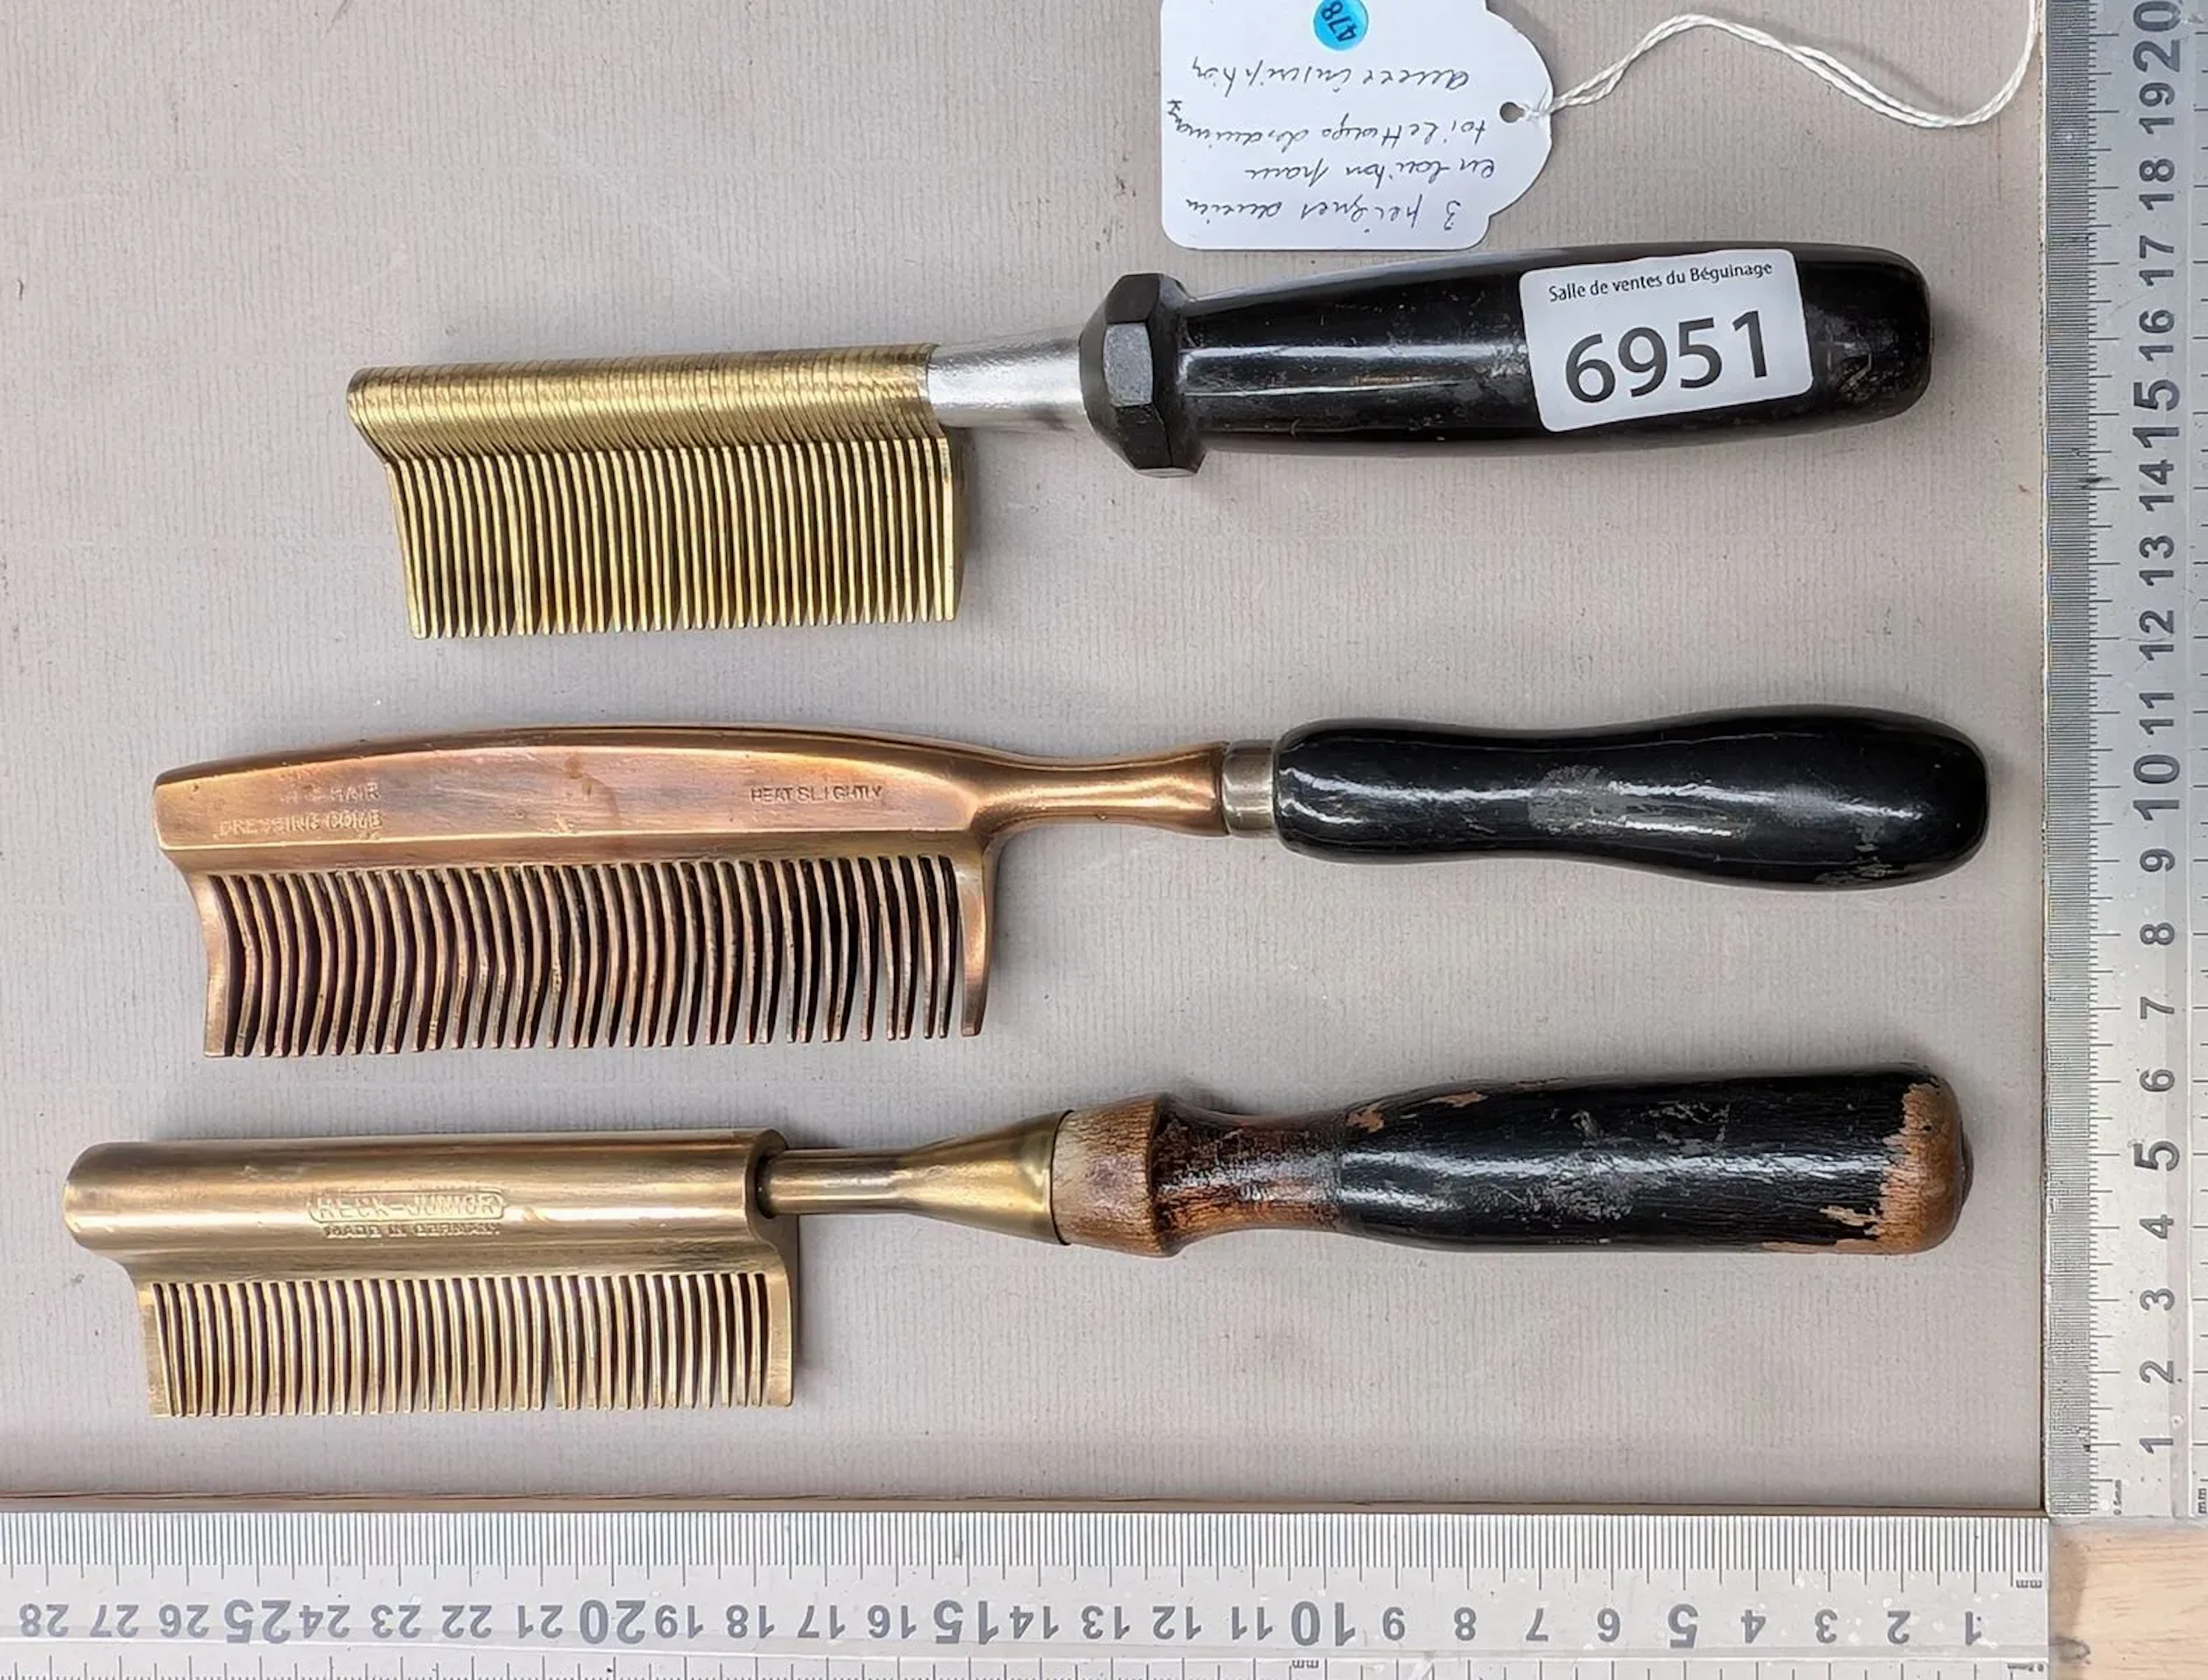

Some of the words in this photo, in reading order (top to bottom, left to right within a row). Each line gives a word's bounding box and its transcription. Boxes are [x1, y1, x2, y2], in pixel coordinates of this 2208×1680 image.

[1321, 0, 1358, 43] 478
[2133, 1, 2181, 72] 20
[2138, 82, 2175, 135] 19
[2138, 158, 2175, 210] 18
[1444, 200, 1462, 231] 3
[2138, 235, 2175, 286] 17
[1549, 284, 1586, 302] Salle
[1590, 279, 1608, 296] de
[1612, 274, 1662, 292] ventes
[1666, 269, 1686, 285] du
[1690, 262, 1773, 283] Béguinage
[2138, 309, 2175, 362] 16
[1565, 309, 1769, 404] 6951
[2133, 379, 2181, 448] 15
[2138, 459, 2175, 512] 14
[2138, 535, 2175, 586] 13
[2138, 610, 2175, 661] 12
[2138, 692, 2175, 735] 11
[2133, 754, 2181, 821] 10
[2138, 849, 2175, 872] 9
[2138, 922, 2175, 946] 8
[2138, 996, 2175, 1019] 7
[2138, 1069, 2175, 1092] 6
[2133, 1141, 2181, 1172] 5
[324, 1225, 382, 1239] MADE
[388, 1223, 407, 1238] IN
[2138, 1214, 2175, 1240] 4
[2138, 1288, 2175, 1313] 3
[2138, 1360, 2175, 1384] 2
[2138, 1435, 2175, 1455] 1
[2015, 1579, 2042, 1589] mm
[19, 1603, 70, 1637] 28
[89, 1604, 140, 1637] 27
[159, 1604, 209, 1638] 26
[225, 1599, 291, 1644] 25
[299, 1604, 351, 1638] 24
[371, 1604, 421, 1638] 23
[442, 1604, 493, 1638] 22
[518, 1605, 563, 1639] 21
[579, 1600, 646, 1641] 20
[655, 1605, 703, 1639] 19
[726, 1605, 775, 1639] 18
[798, 1605, 845, 1639] 17
[868, 1605, 916, 1639] 16
[933, 1600, 998, 1645] 15
[1009, 1605, 1059, 1639] 14
[1082, 1606, 1130, 1639] 13
[1153, 1606, 1201, 1640] 12
[1231, 1606, 1272, 1640] 11
[1291, 1601, 1355, 1647] 10
[1382, 1606, 1405, 1641] 9
[1454, 1608, 1477, 1641] 8
[1526, 1609, 1548, 1641] 7
[1597, 1609, 1620, 1643] 6
[1669, 1604, 1699, 1648] 5
[1741, 1610, 1766, 1643] 4
[1815, 1611, 1838, 1644] 3
[1888, 1612, 1910, 1644] 2
[1964, 1612, 1981, 1646] 1
[1291, 1659, 1320, 1669] mm
